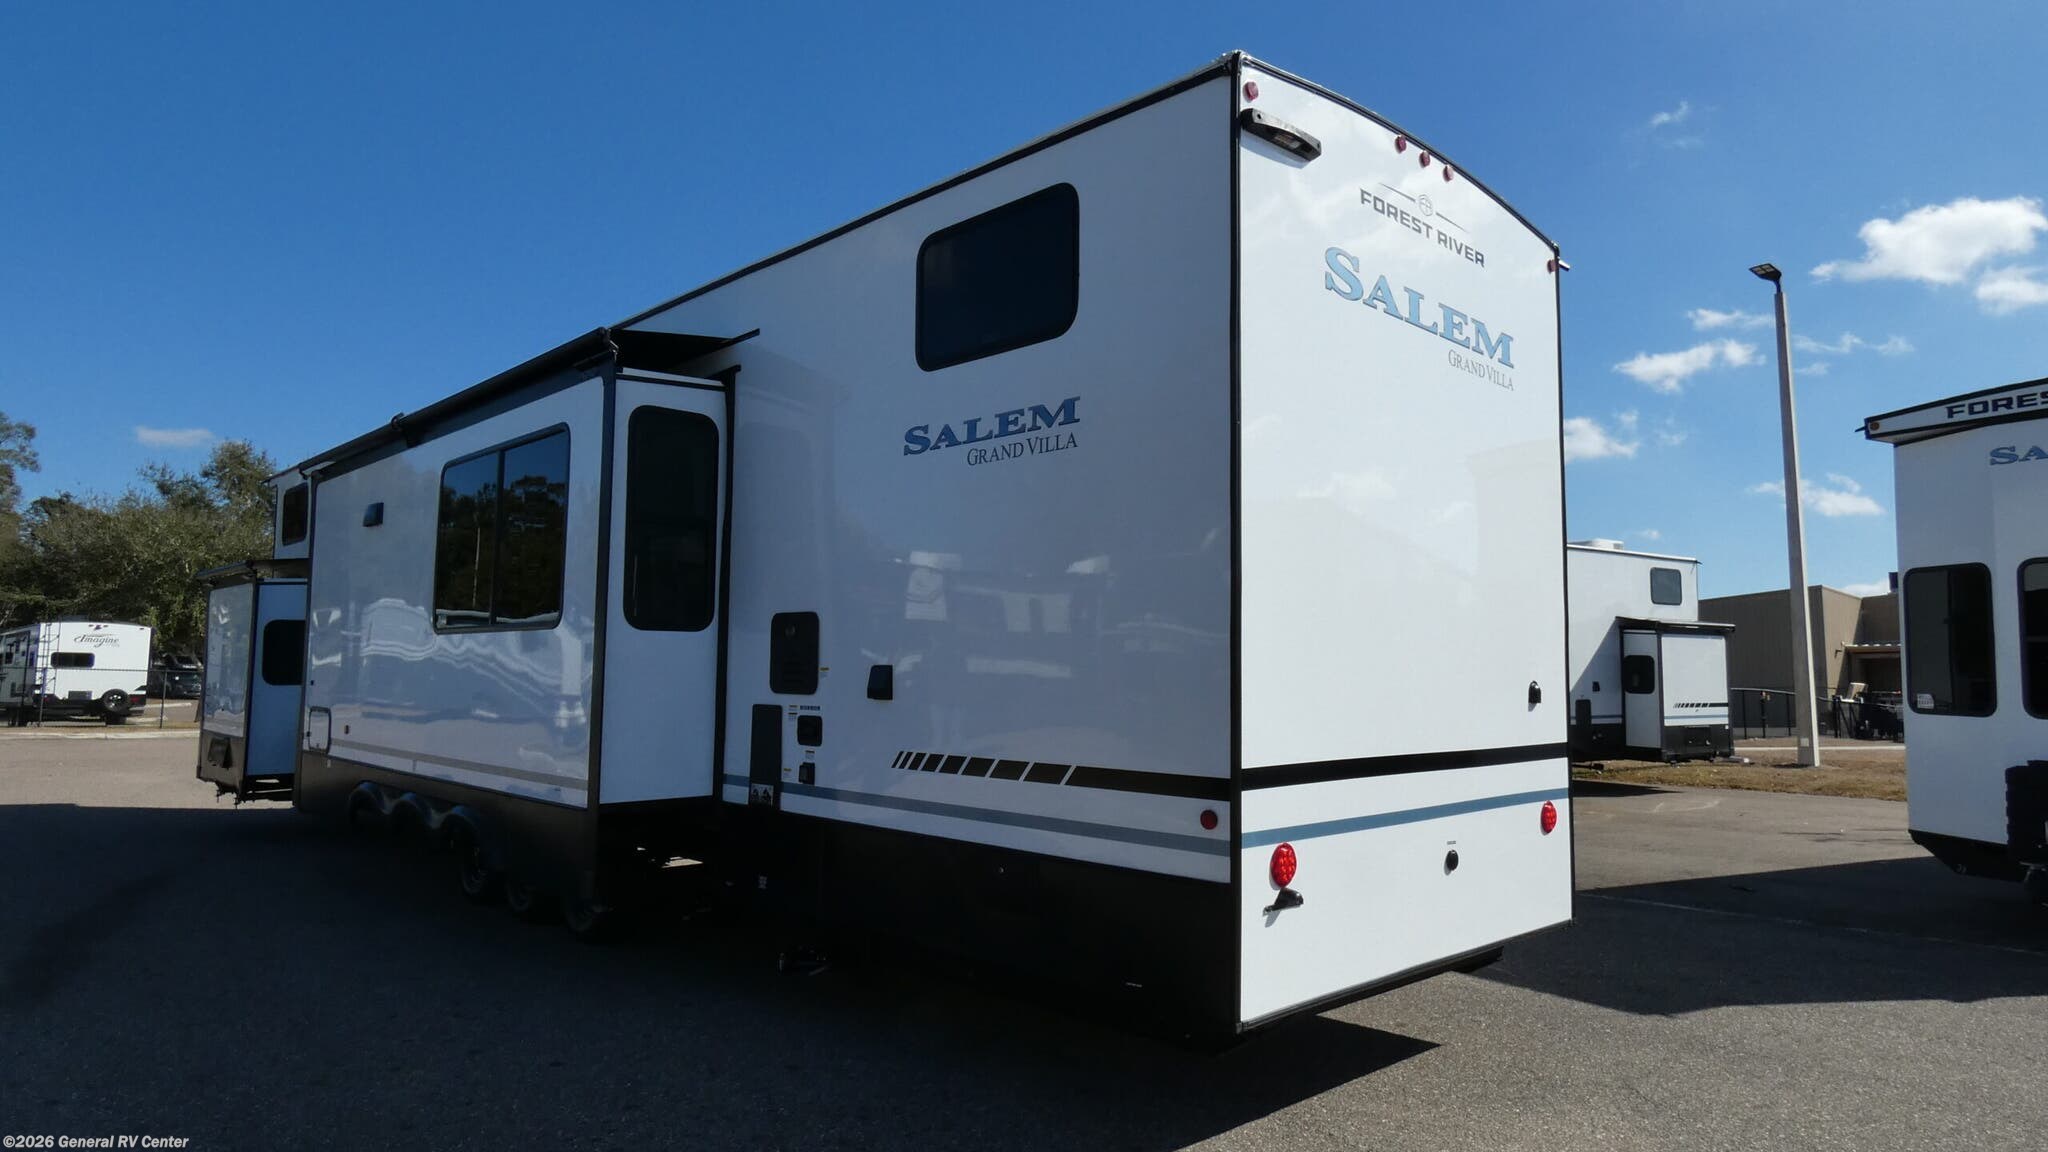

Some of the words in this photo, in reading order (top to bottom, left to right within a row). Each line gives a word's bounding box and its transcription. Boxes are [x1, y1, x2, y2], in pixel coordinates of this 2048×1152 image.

[1360, 189, 1432, 239] FOREST
[1437, 229, 1485, 268] RIVER
[1325, 246, 1514, 369] SALEM
[1448, 349, 1486, 379] GRAND
[1486, 363, 1514, 392] VILLA
[904, 396, 1081, 456] SALEM
[967, 442, 1024, 466] GRAND
[1026, 432, 1078, 455] VILLA
